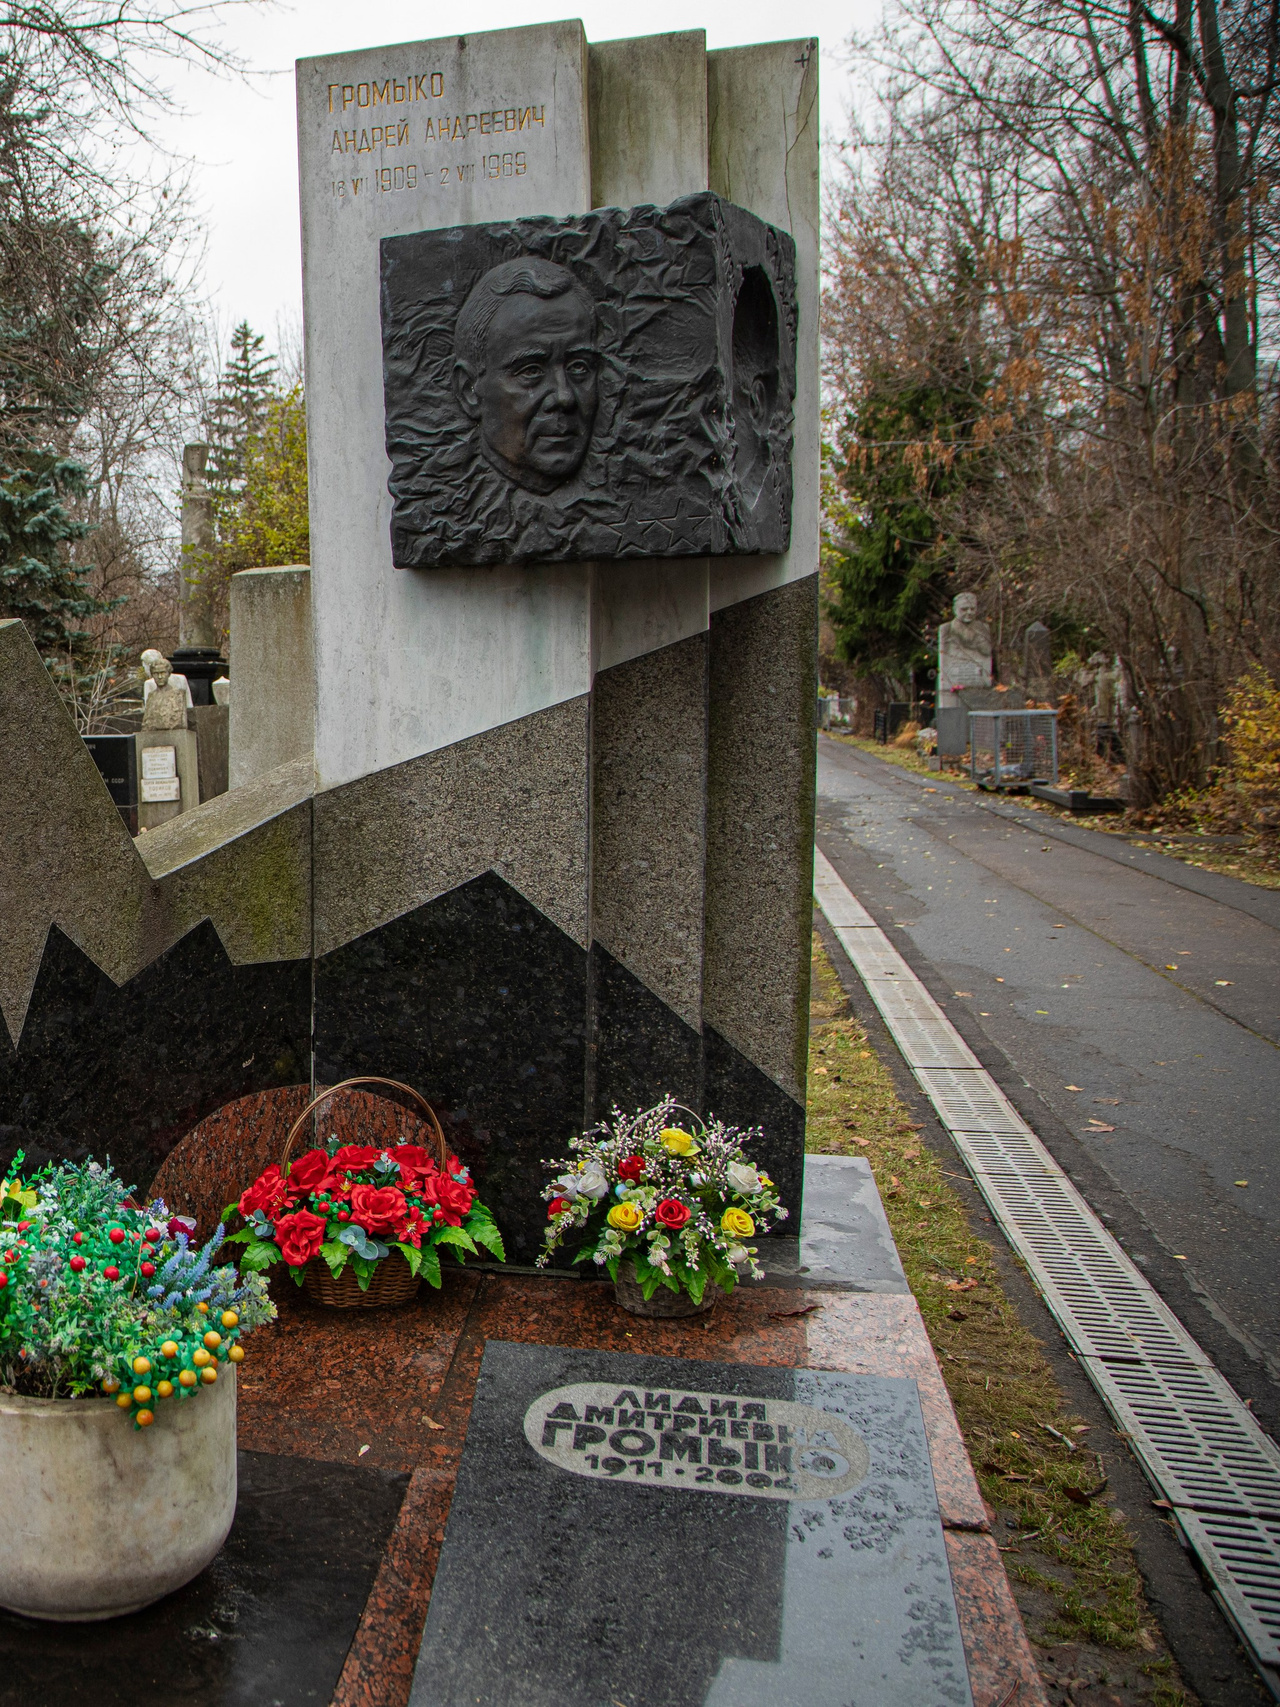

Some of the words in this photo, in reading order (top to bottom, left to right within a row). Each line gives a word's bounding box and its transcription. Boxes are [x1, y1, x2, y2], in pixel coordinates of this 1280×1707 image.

[328, 72, 444, 113] ГРОМЫКО
[331, 118, 410, 155] АНДРЕЙ
[425, 104, 546, 144] АНДРЕЕВИЧ
[331, 179, 346, 198] 18
[375, 164, 418, 194] 1909
[440, 167, 450, 187] 2
[482, 151, 528, 181] 1989
[546, 1401, 841, 1449] ДМИТРИЕВНА
[613, 1390, 767, 1422] ЛИДИЯ
[541, 1419, 851, 1479] ГРОМЫКО
[584, 1454, 664, 1477] 1911
